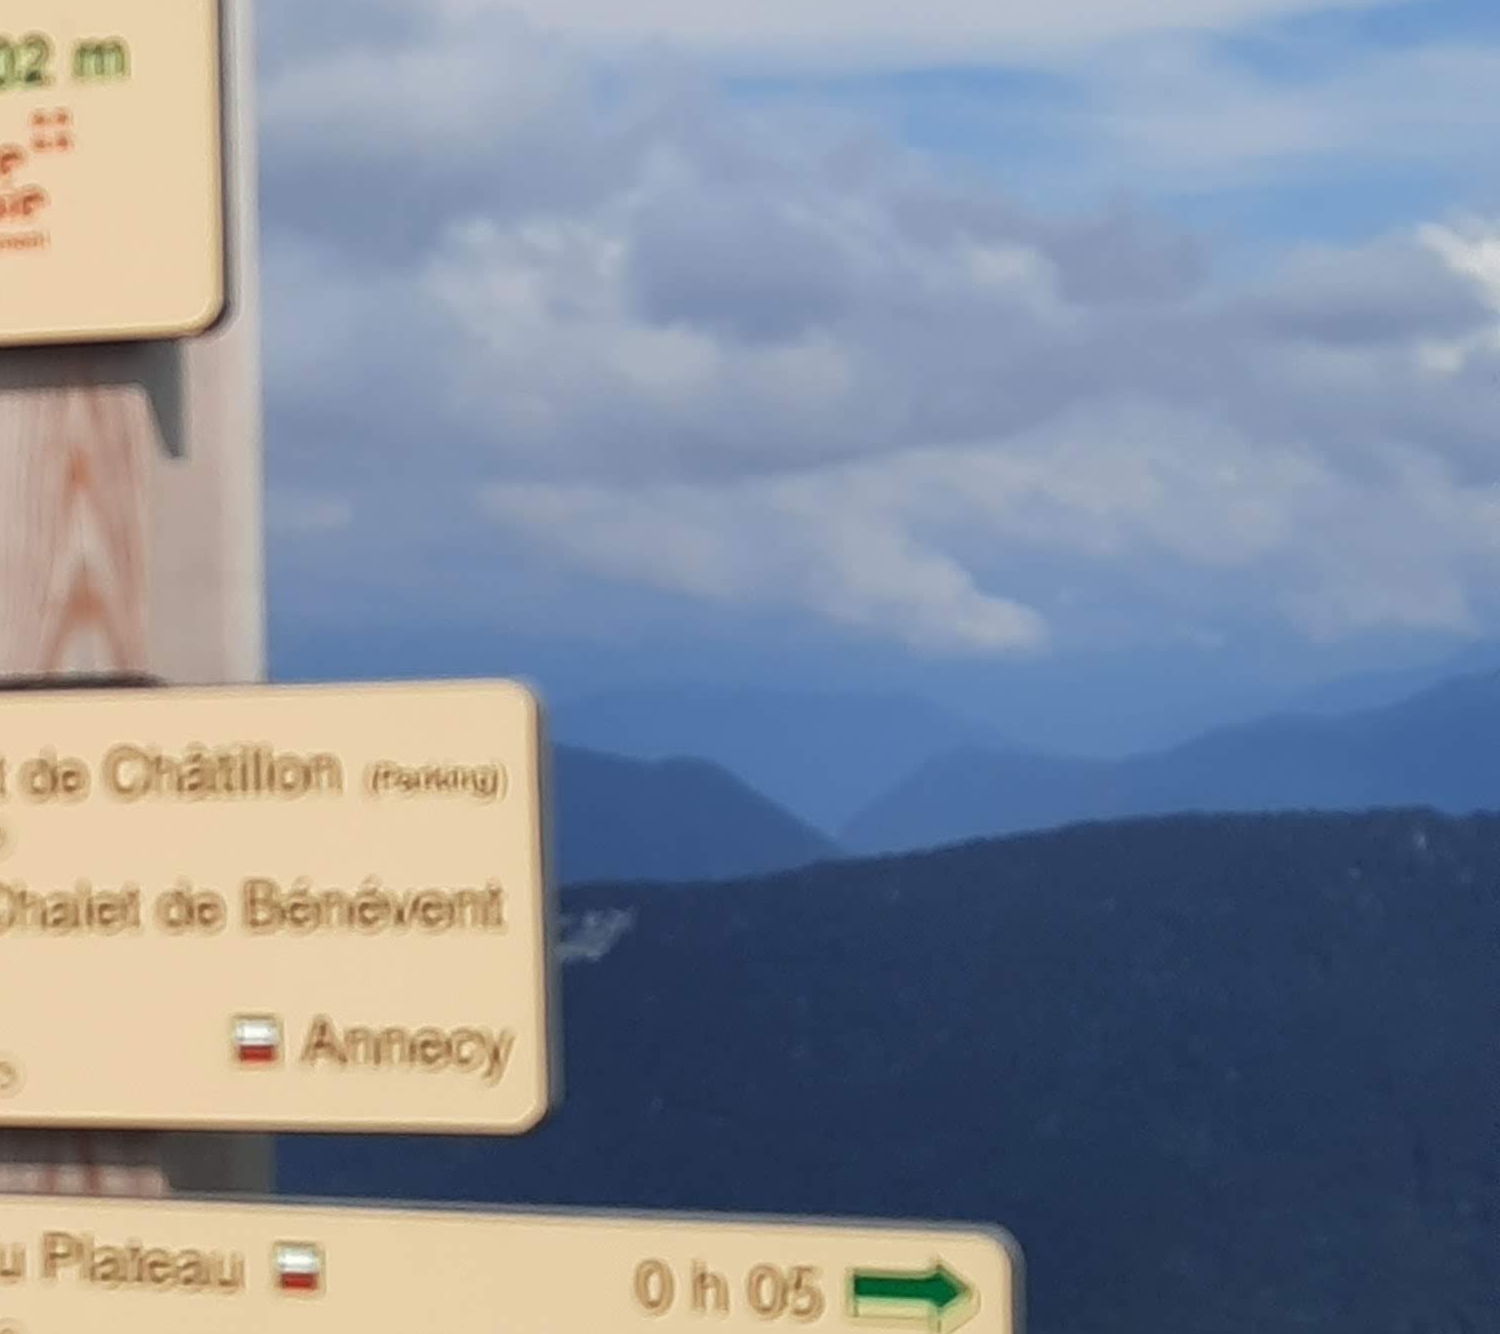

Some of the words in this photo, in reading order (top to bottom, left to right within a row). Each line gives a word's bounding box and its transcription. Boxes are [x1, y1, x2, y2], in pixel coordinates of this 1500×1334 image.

[73, 40, 127, 81] m
[22, 747, 89, 801] de
[103, 746, 342, 801] Châtillon
[366, 763, 507, 798] (Parking)
[156, 879, 226, 934] de
[242, 877, 506, 935] Bénévent
[301, 1014, 514, 1082] Annecy
[42, 1232, 244, 1294] Plateau
[634, 1259, 674, 1315] 0
[690, 1257, 730, 1314] h
[747, 1265, 824, 1323] 05
